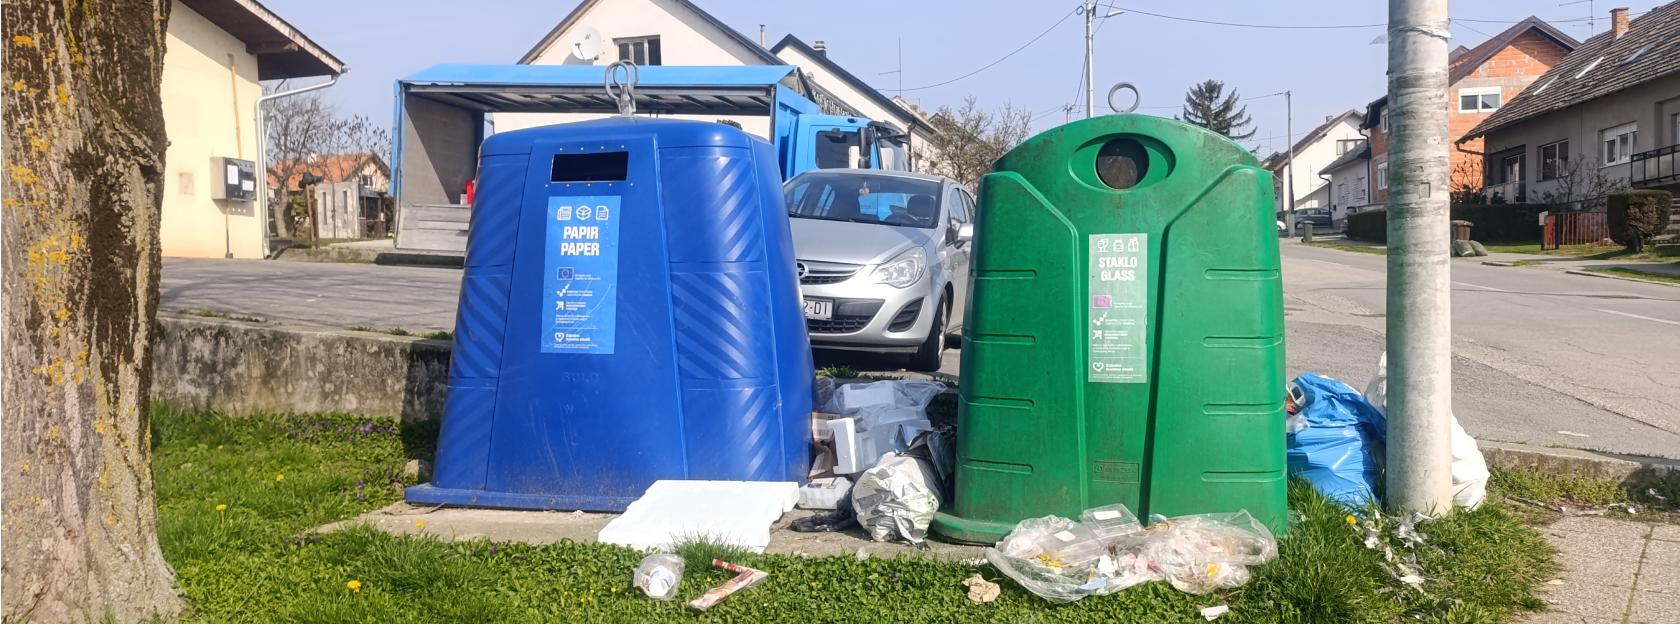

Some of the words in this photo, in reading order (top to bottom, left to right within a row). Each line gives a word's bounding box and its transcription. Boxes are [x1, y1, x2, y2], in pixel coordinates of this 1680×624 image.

[563, 226, 599, 240] PAPIR
[560, 242, 600, 256] PAPER
[1098, 256, 1138, 269] STAKLO
[1101, 270, 1136, 282] GLASS
